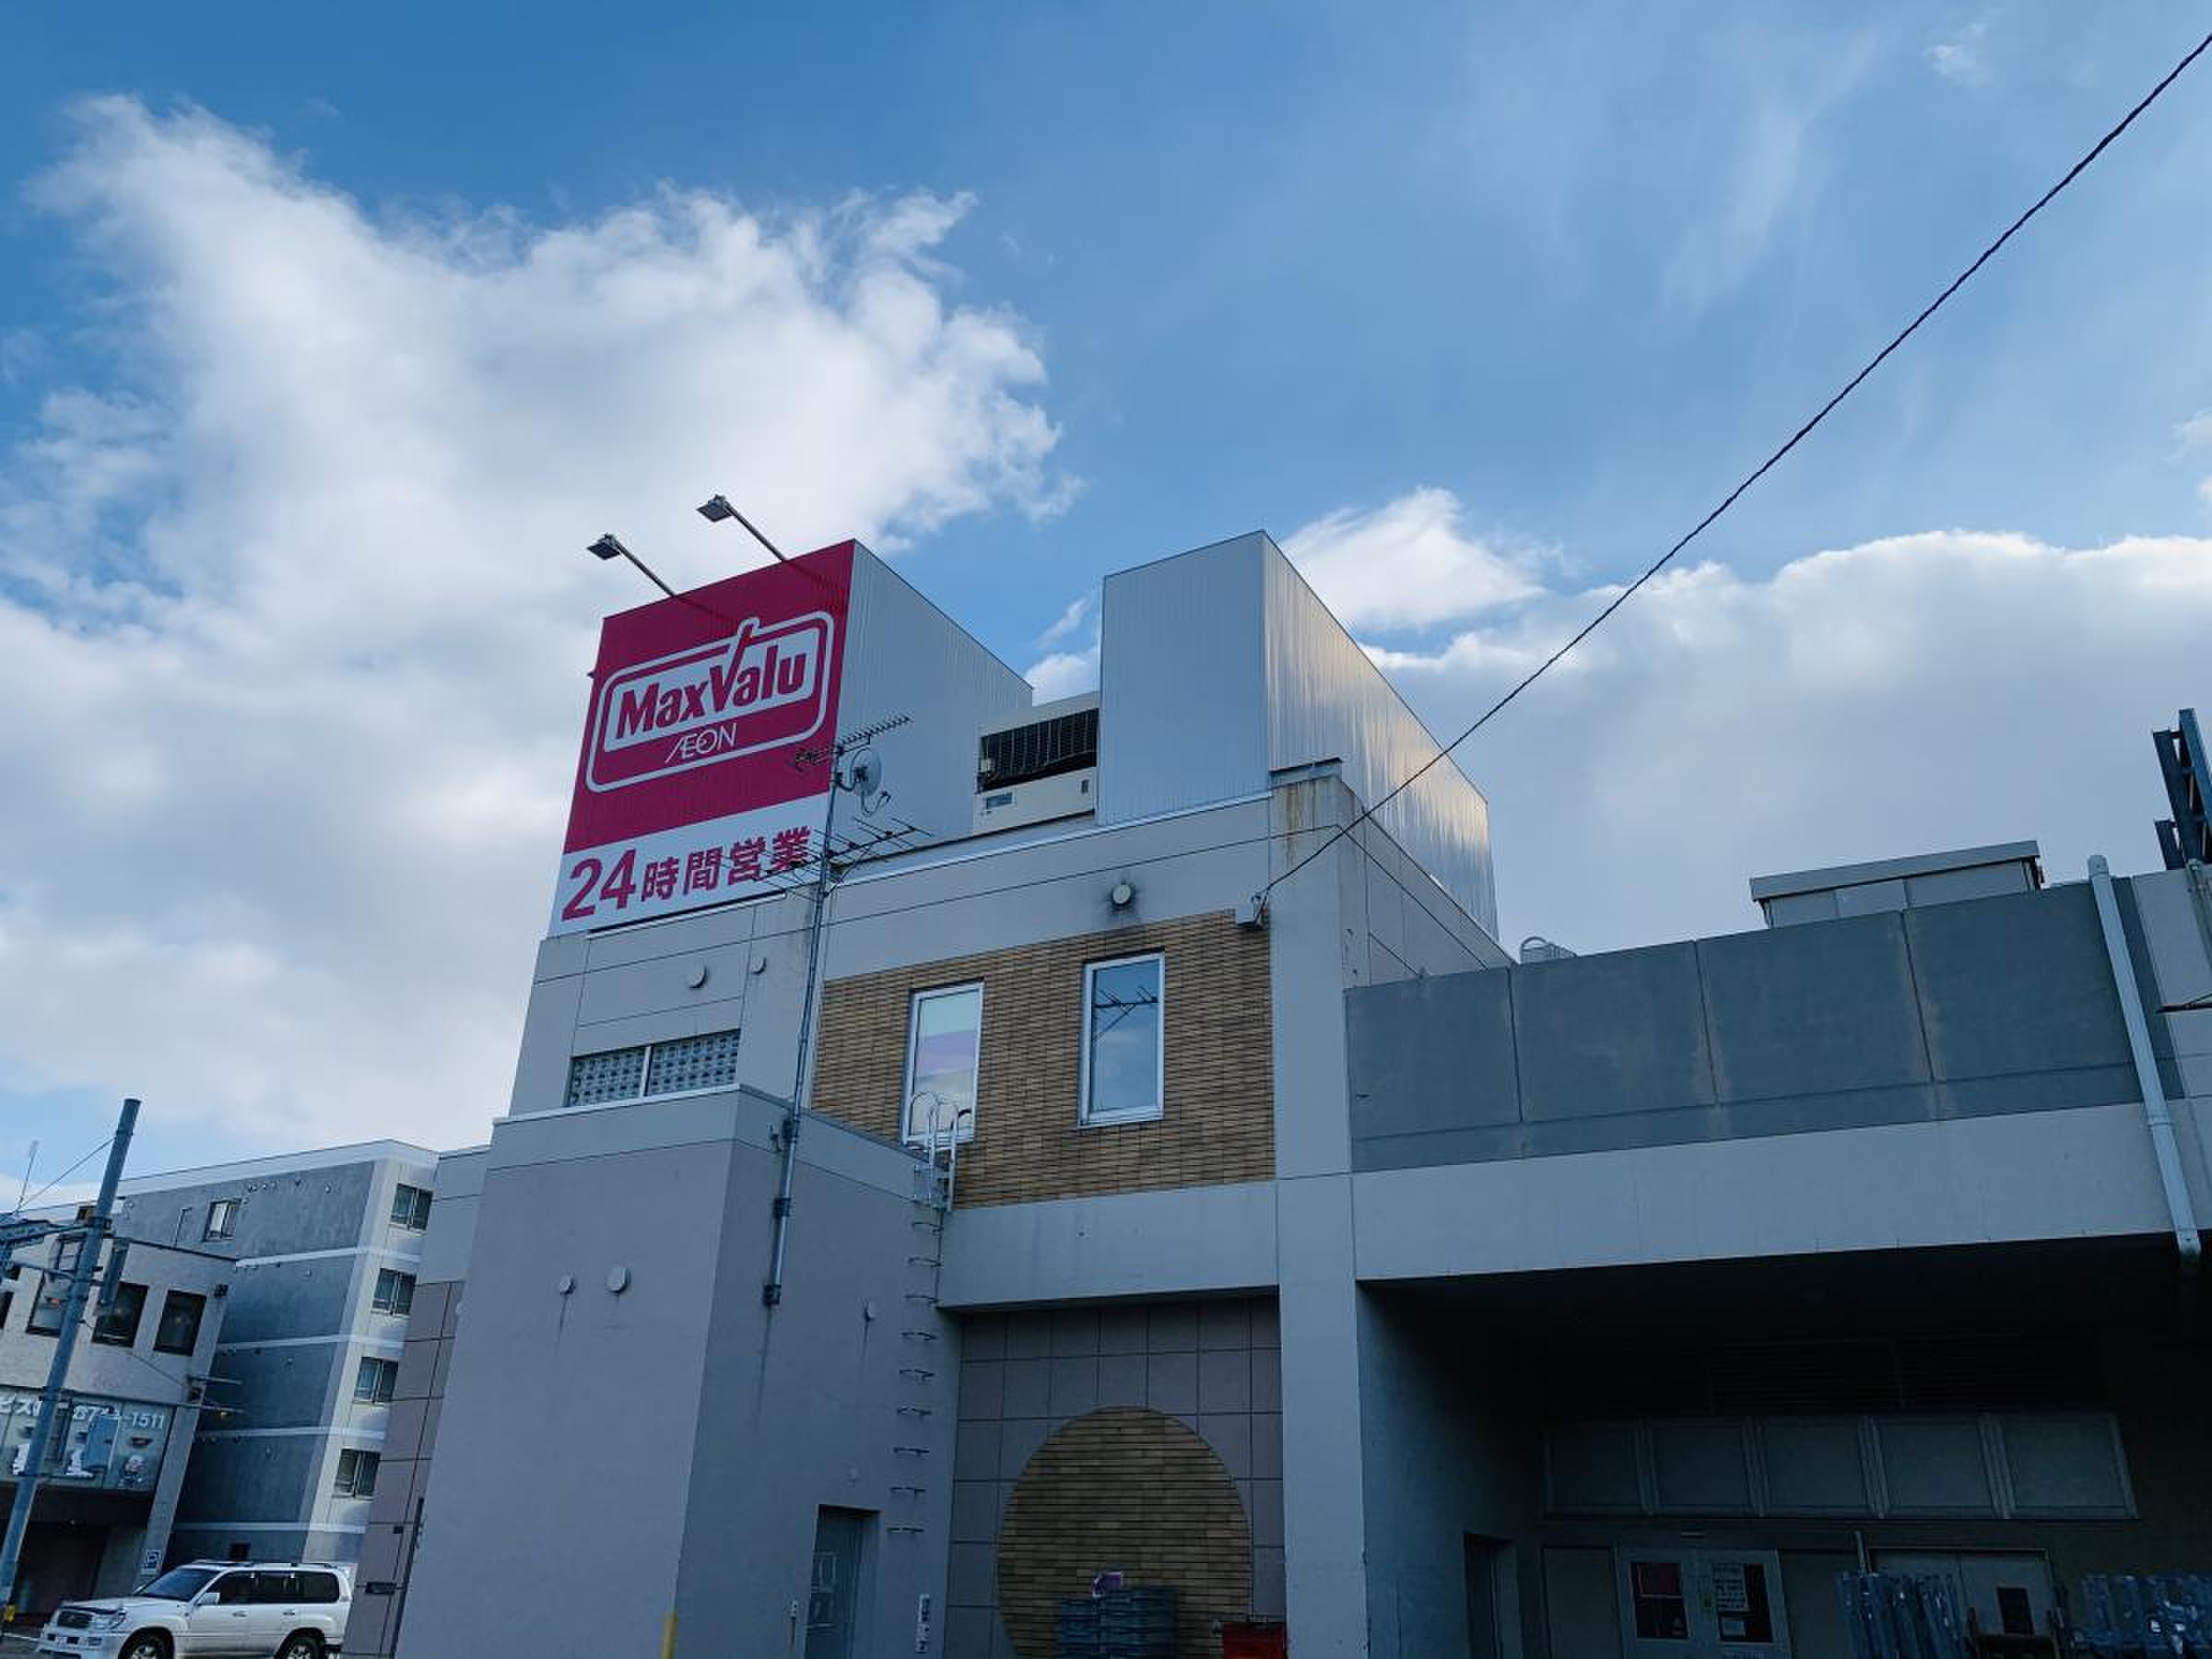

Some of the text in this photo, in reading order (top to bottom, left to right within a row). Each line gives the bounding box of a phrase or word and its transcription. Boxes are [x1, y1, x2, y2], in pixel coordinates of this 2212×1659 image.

[616, 625, 806, 739] MaxValu
[561, 826, 811, 921] 24時間営業
